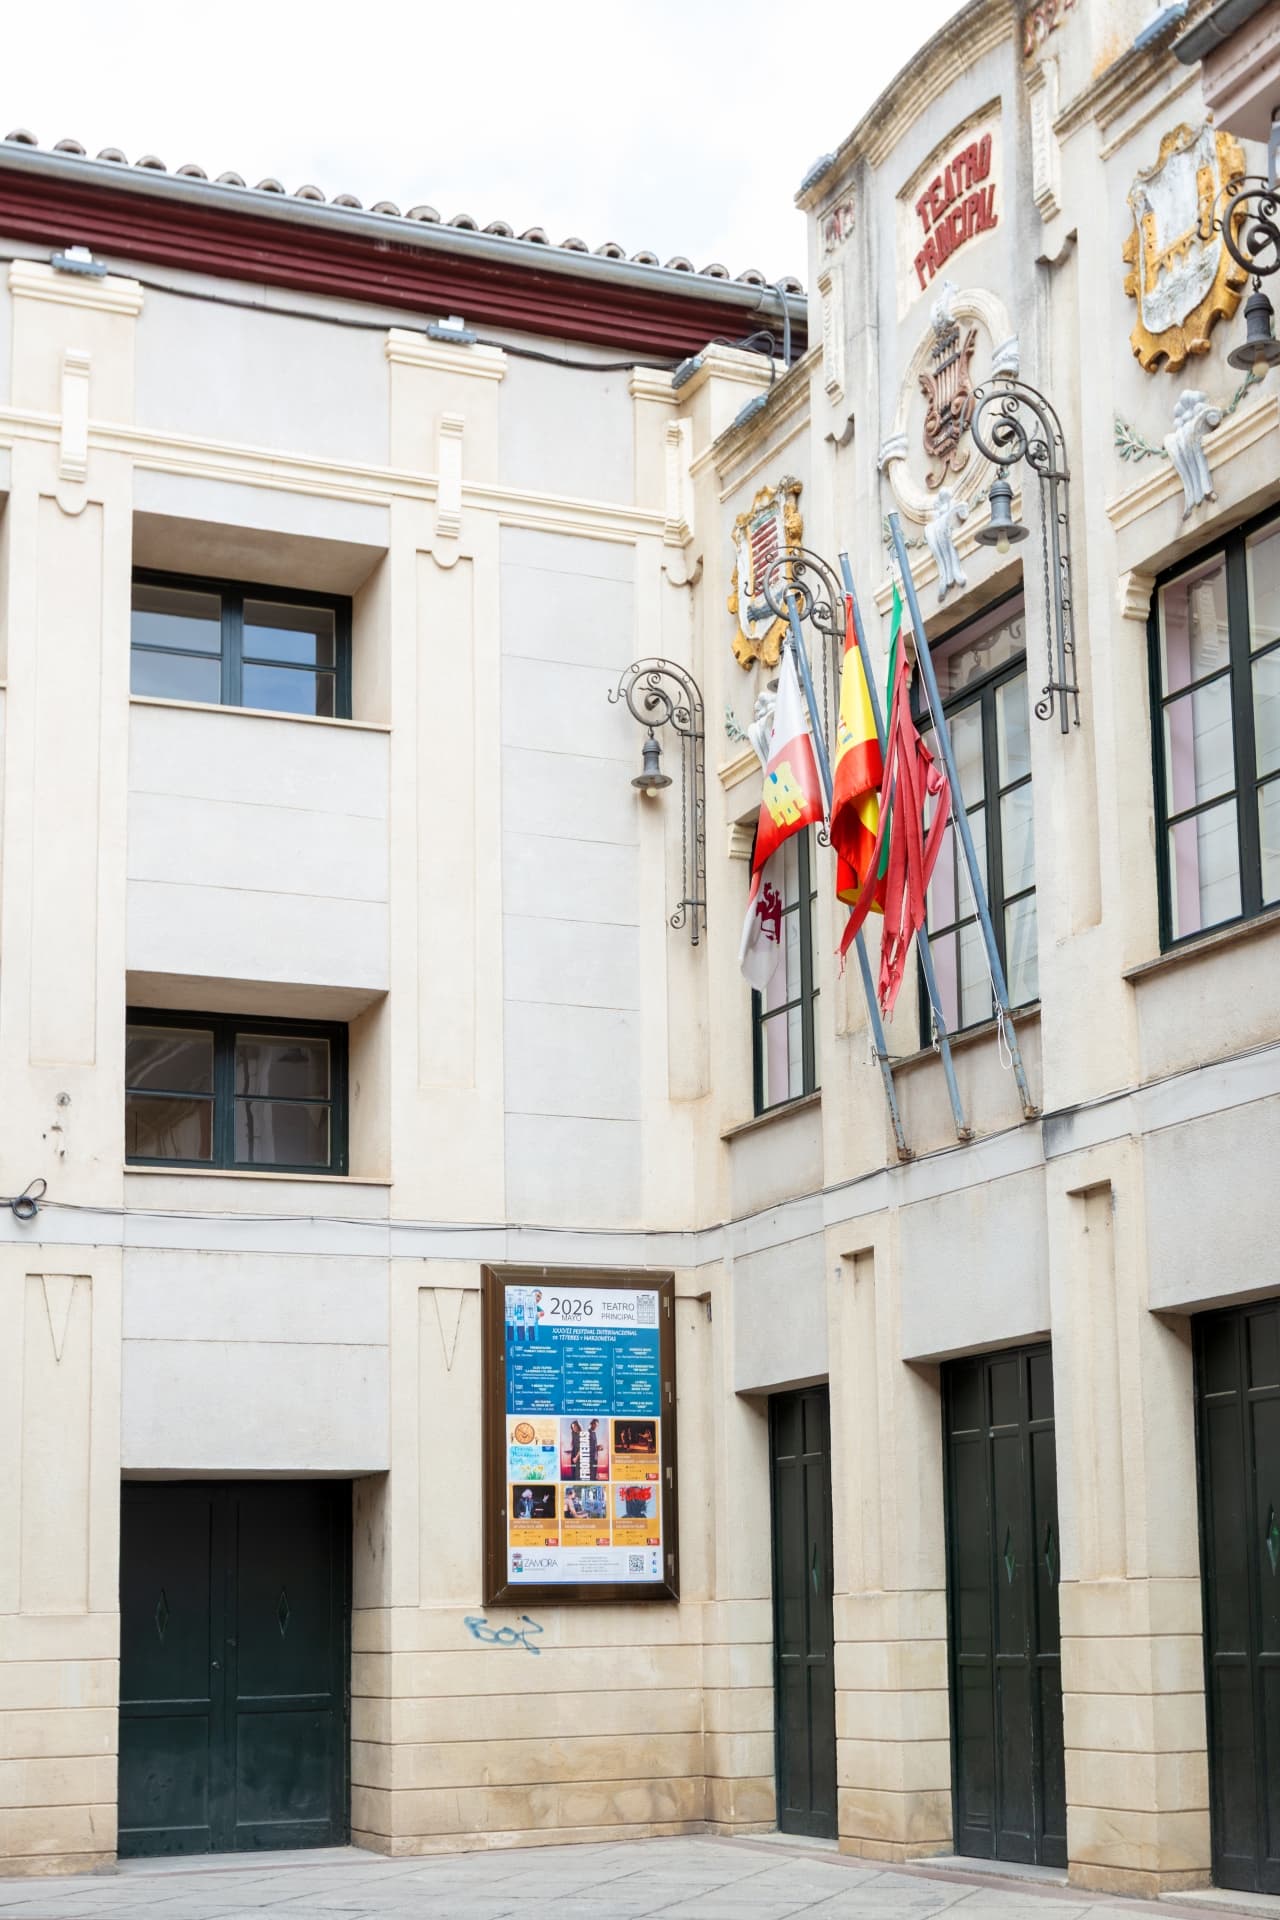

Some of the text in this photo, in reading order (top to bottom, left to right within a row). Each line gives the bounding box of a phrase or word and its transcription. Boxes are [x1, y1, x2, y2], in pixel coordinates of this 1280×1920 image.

[915, 133, 992, 234] TEATRO
[914, 183, 998, 291] PRINCIPAL
[550, 1297, 594, 1316] 2026
[602, 1302, 635, 1312] TEATRO
[561, 1314, 582, 1322] MAYO
[601, 1312, 636, 1321] PRINCIPAL
[524, 1558, 559, 1568] ZAMORA
